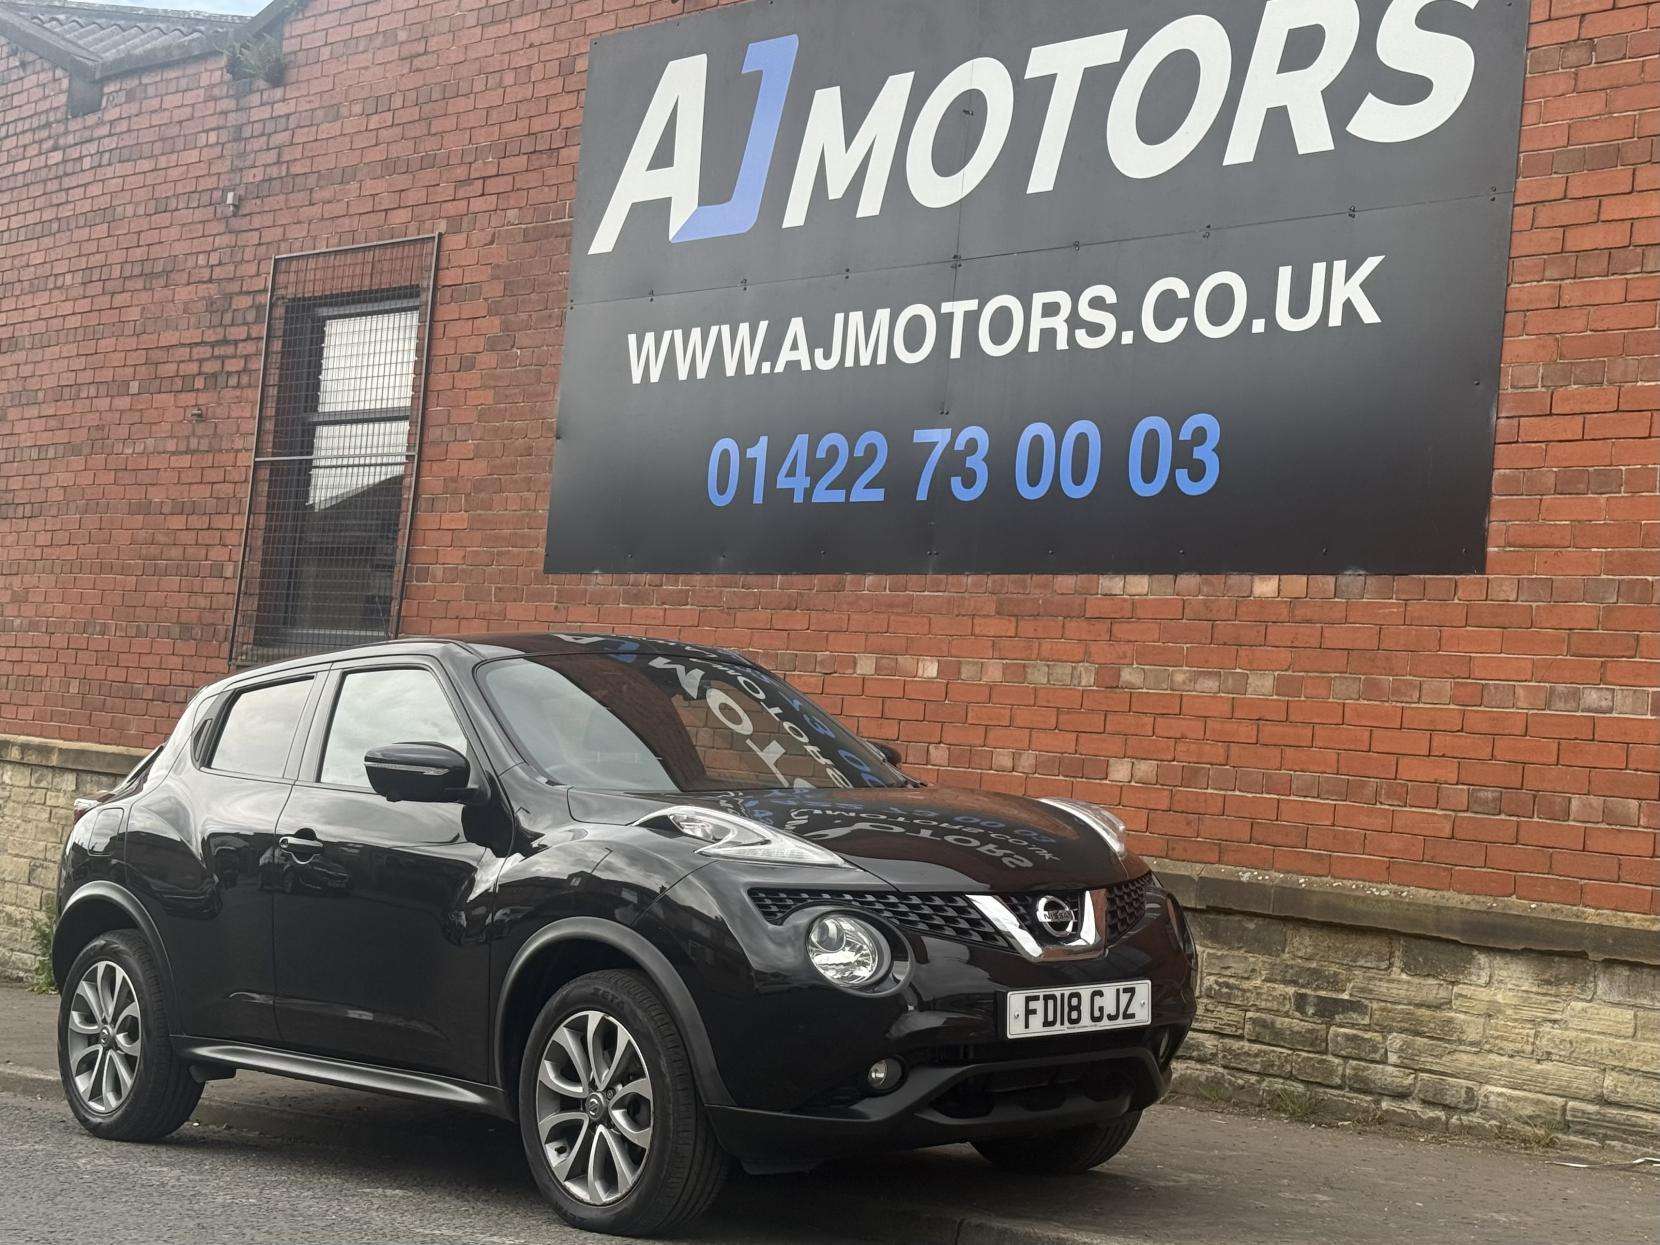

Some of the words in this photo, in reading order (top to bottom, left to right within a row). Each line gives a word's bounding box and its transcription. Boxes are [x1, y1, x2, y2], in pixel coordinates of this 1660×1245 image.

[587, 35, 798, 256] AJ
[781, 0, 1480, 229] MOTORS
[627, 254, 1386, 385] WWW.AJMOTORS.CO.UK
[707, 430, 889, 507] 01422
[912, 425, 990, 501] 73
[1014, 419, 1101, 500] 00
[1127, 412, 1221, 497] 03
[1024, 991, 1082, 1030] FD18
[1089, 986, 1136, 1023] GJZ
